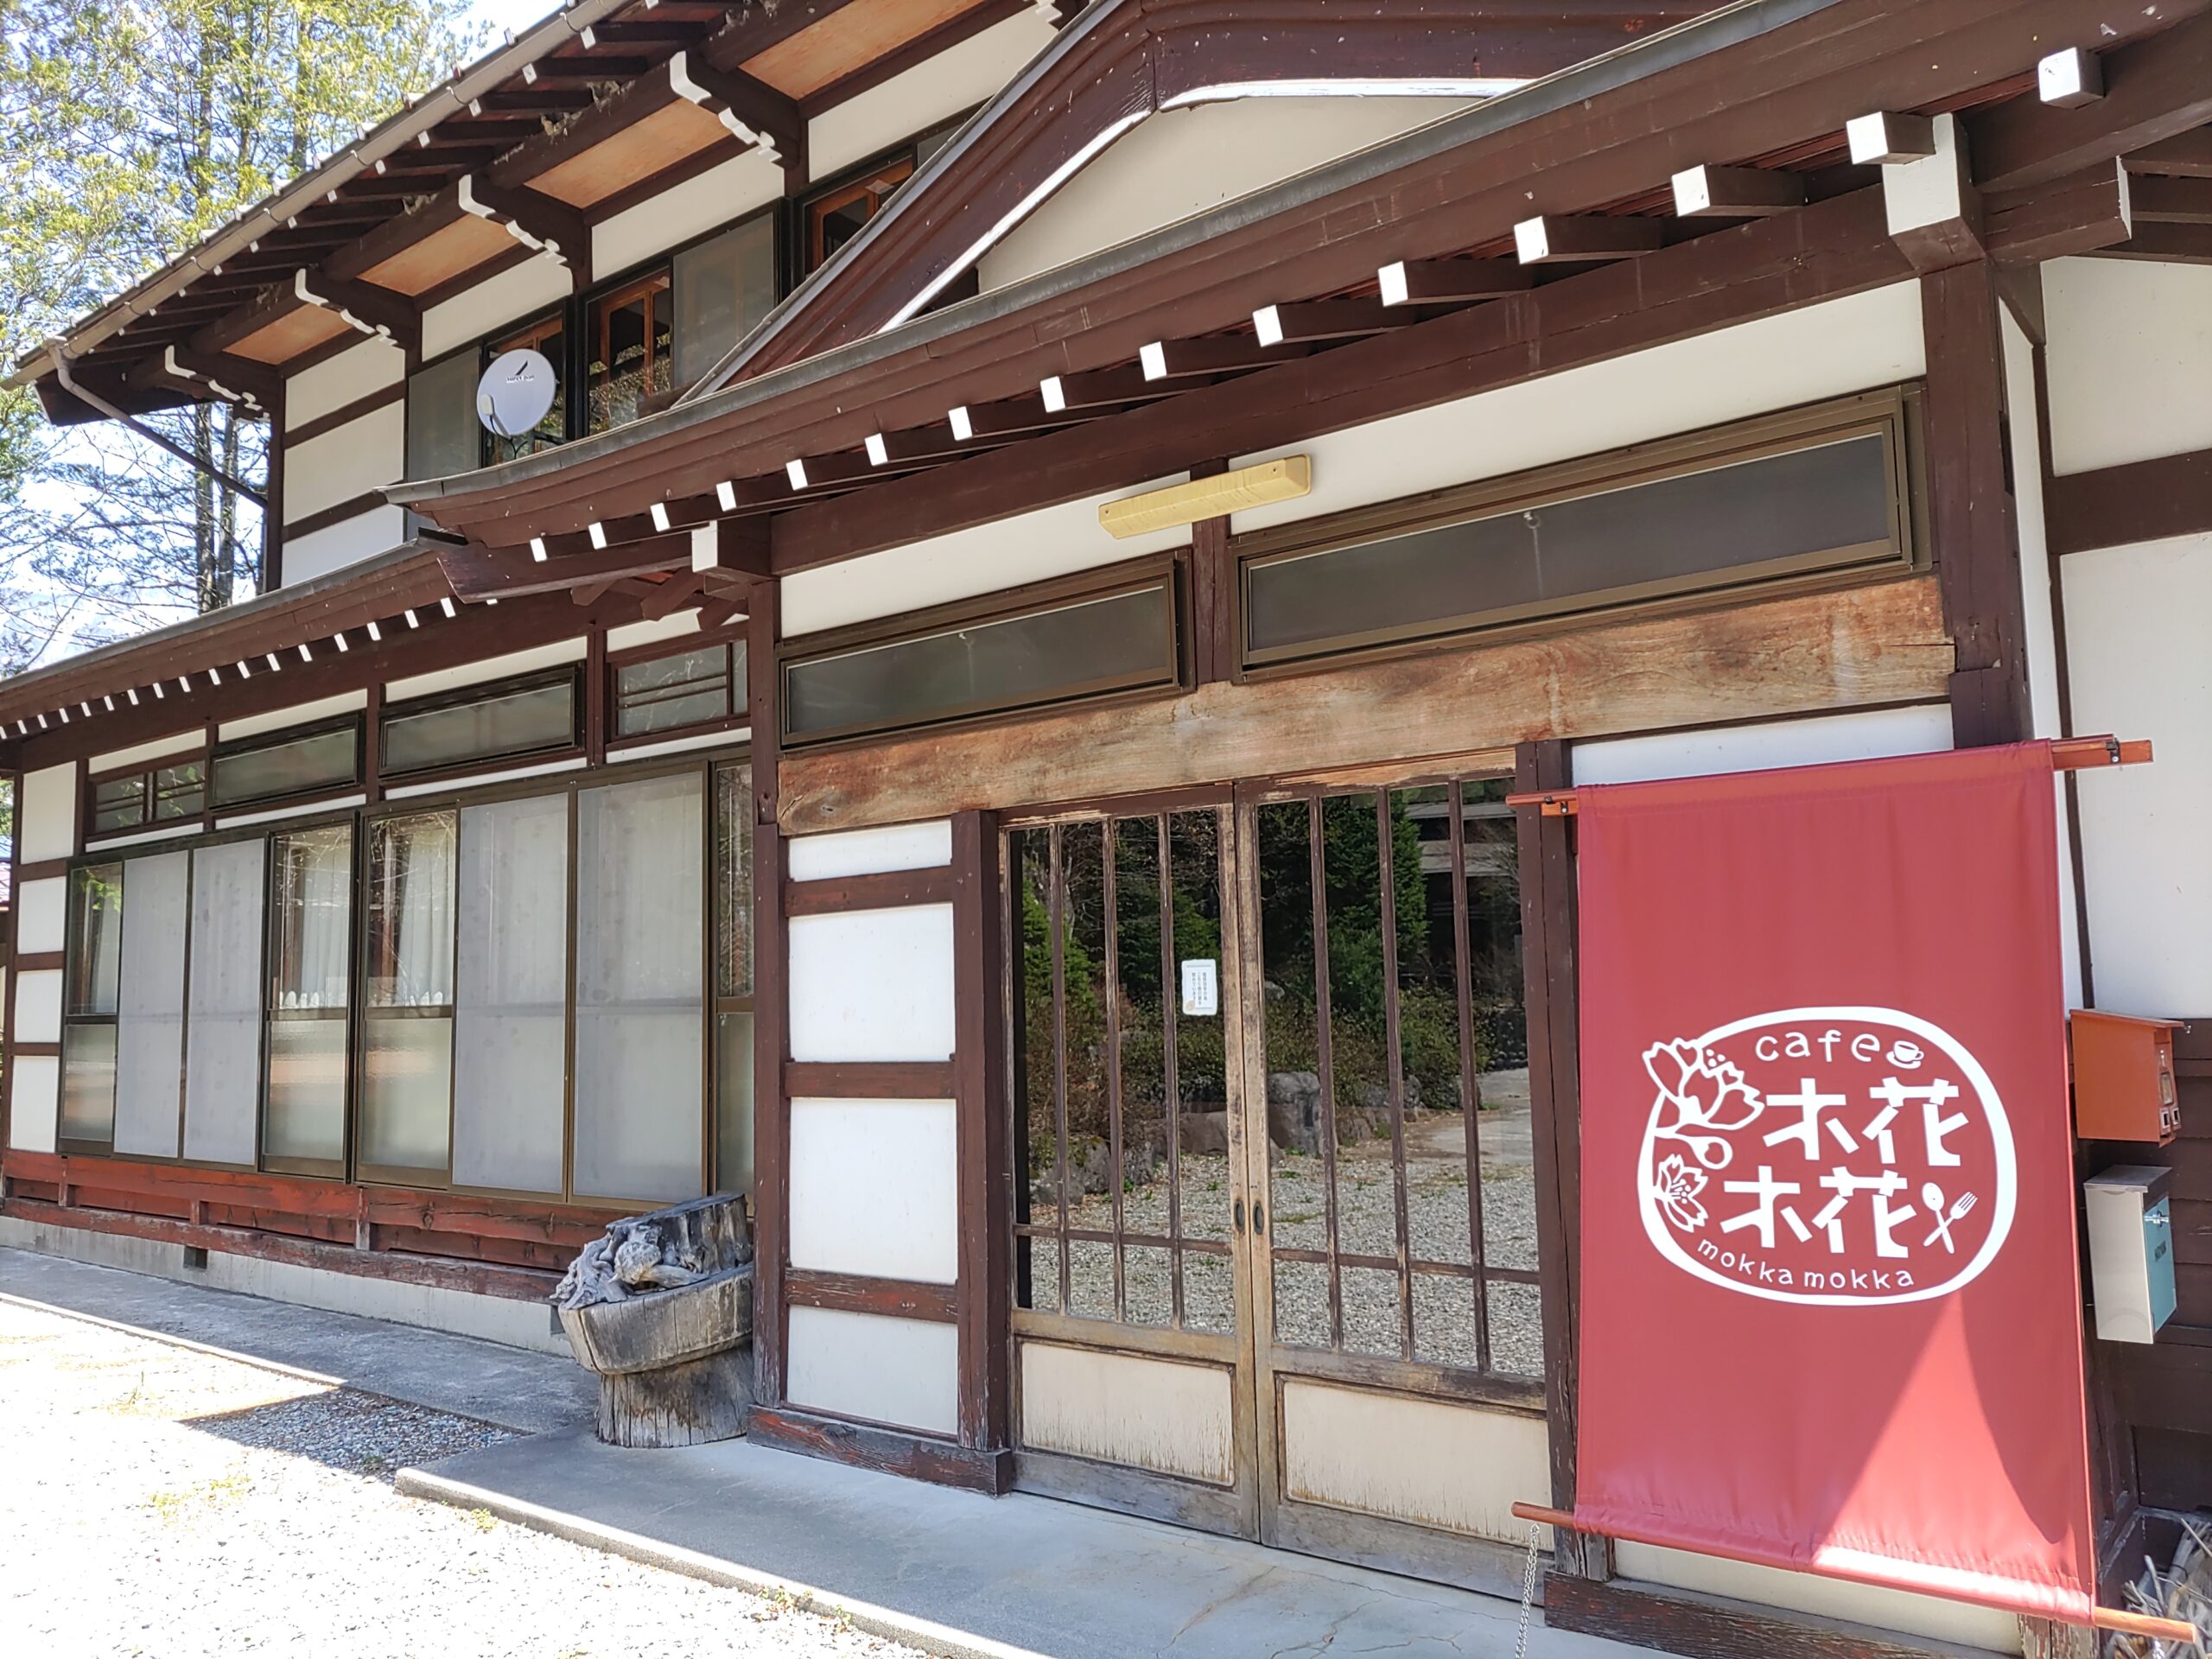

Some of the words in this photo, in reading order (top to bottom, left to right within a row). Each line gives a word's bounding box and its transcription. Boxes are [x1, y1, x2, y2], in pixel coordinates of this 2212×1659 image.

[1755, 1029, 1881, 1063] cafe
[1762, 1076, 1969, 1166] 木花
[1719, 1165, 1917, 1259] 木花
[1697, 1238, 1794, 1285] mokka
[1803, 1268, 1915, 1289] mokka
